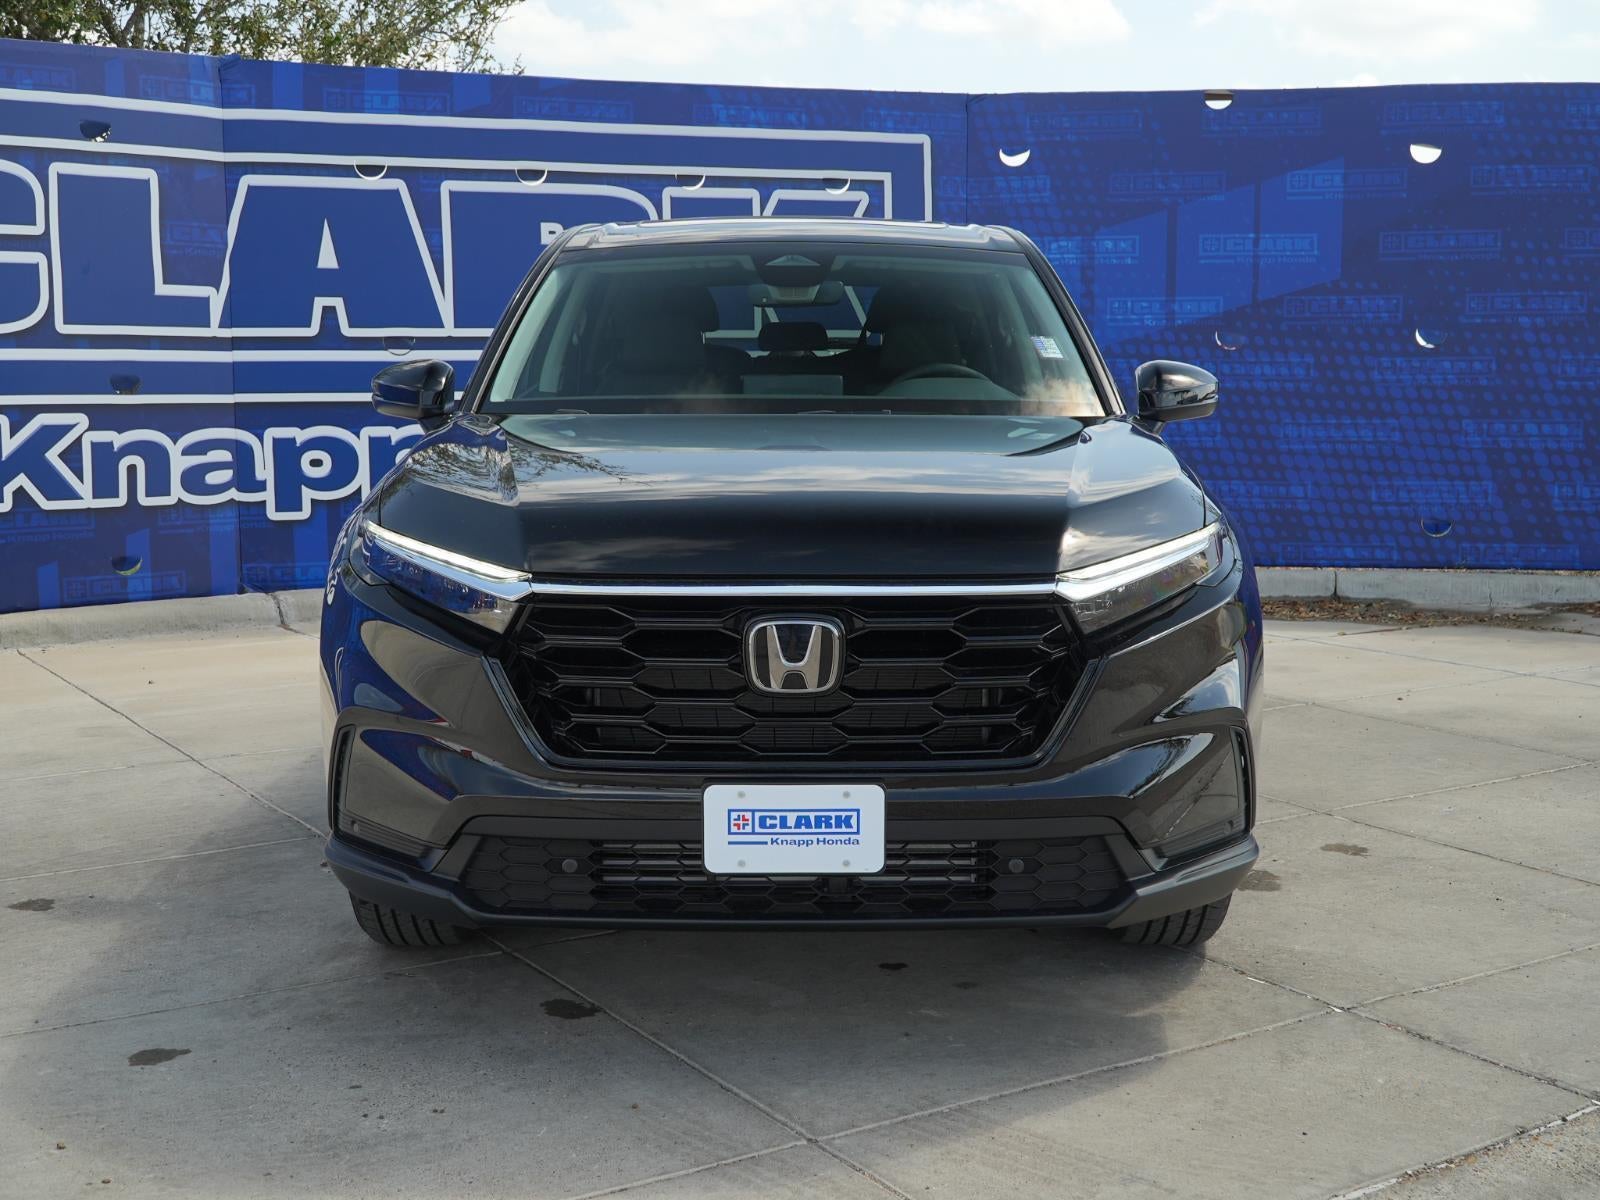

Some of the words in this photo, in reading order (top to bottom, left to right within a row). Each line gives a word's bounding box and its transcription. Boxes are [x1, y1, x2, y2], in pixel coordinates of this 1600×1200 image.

[758, 814, 854, 830] CLARK
[770, 837, 814, 847] Knapp
[816, 837, 860, 846] Honda
